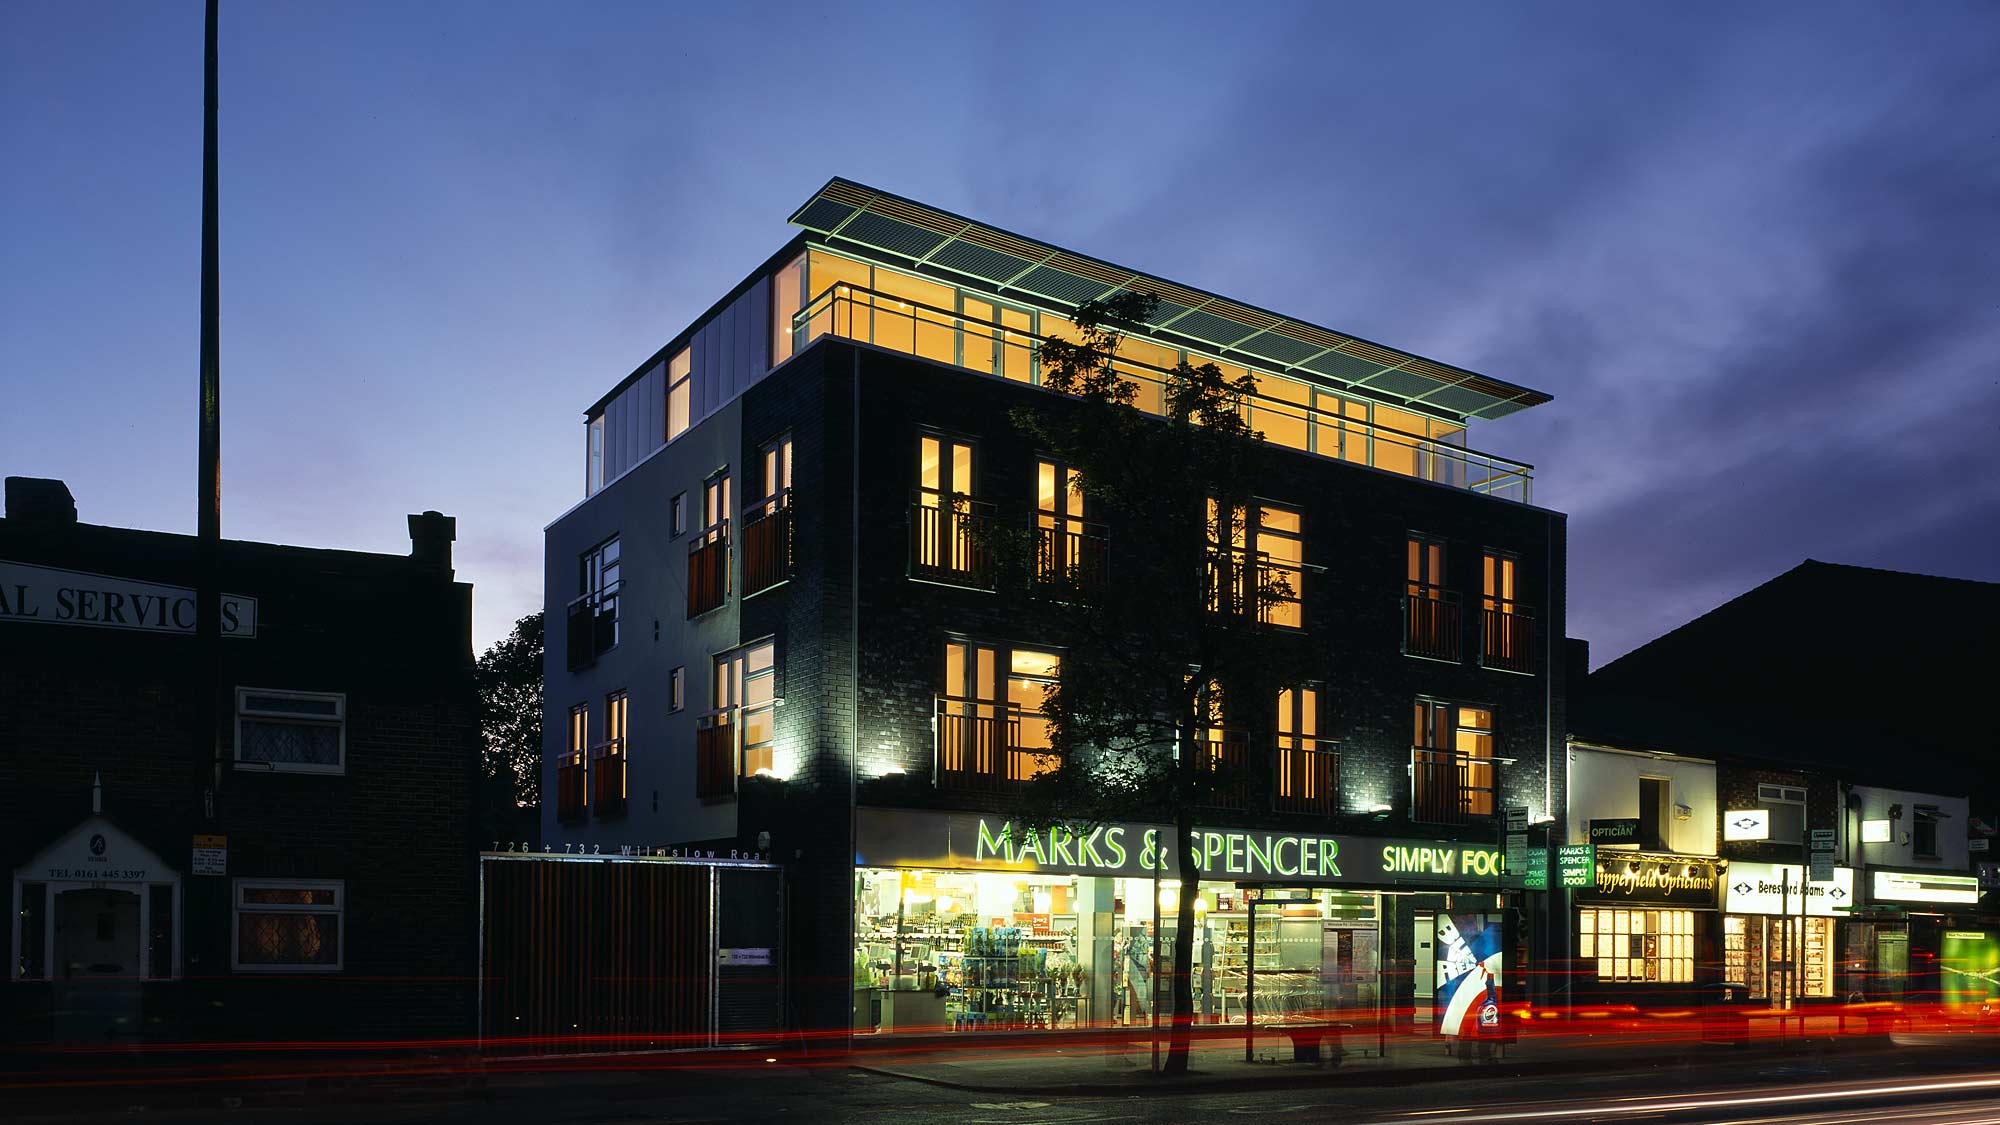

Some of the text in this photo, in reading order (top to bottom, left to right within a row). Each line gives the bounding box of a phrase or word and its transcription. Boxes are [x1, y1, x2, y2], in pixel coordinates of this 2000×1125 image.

[55, 587, 240, 633] SERVICS
[1591, 827, 1633, 837] OPTICIAN
[975, 818, 1127, 869] MARKS
[1139, 828, 1169, 870] &
[492, 841, 529, 853] 726
[565, 843, 601, 855] 732
[621, 845, 715, 859] Wilmslow
[1559, 847, 1584, 855] MARKS
[1382, 845, 1454, 874] SIMPLY
[1462, 850, 1505, 876] FOO
[1559, 856, 1591, 865] SPENCER
[75, 869, 98, 879] 0161
[102, 870, 119, 879] 445
[123, 870, 146, 880] 3397
[1562, 868, 1588, 877] SIMPLY
[1563, 877, 1587, 886] FOOD
[1659, 872, 1714, 896] Opticians
